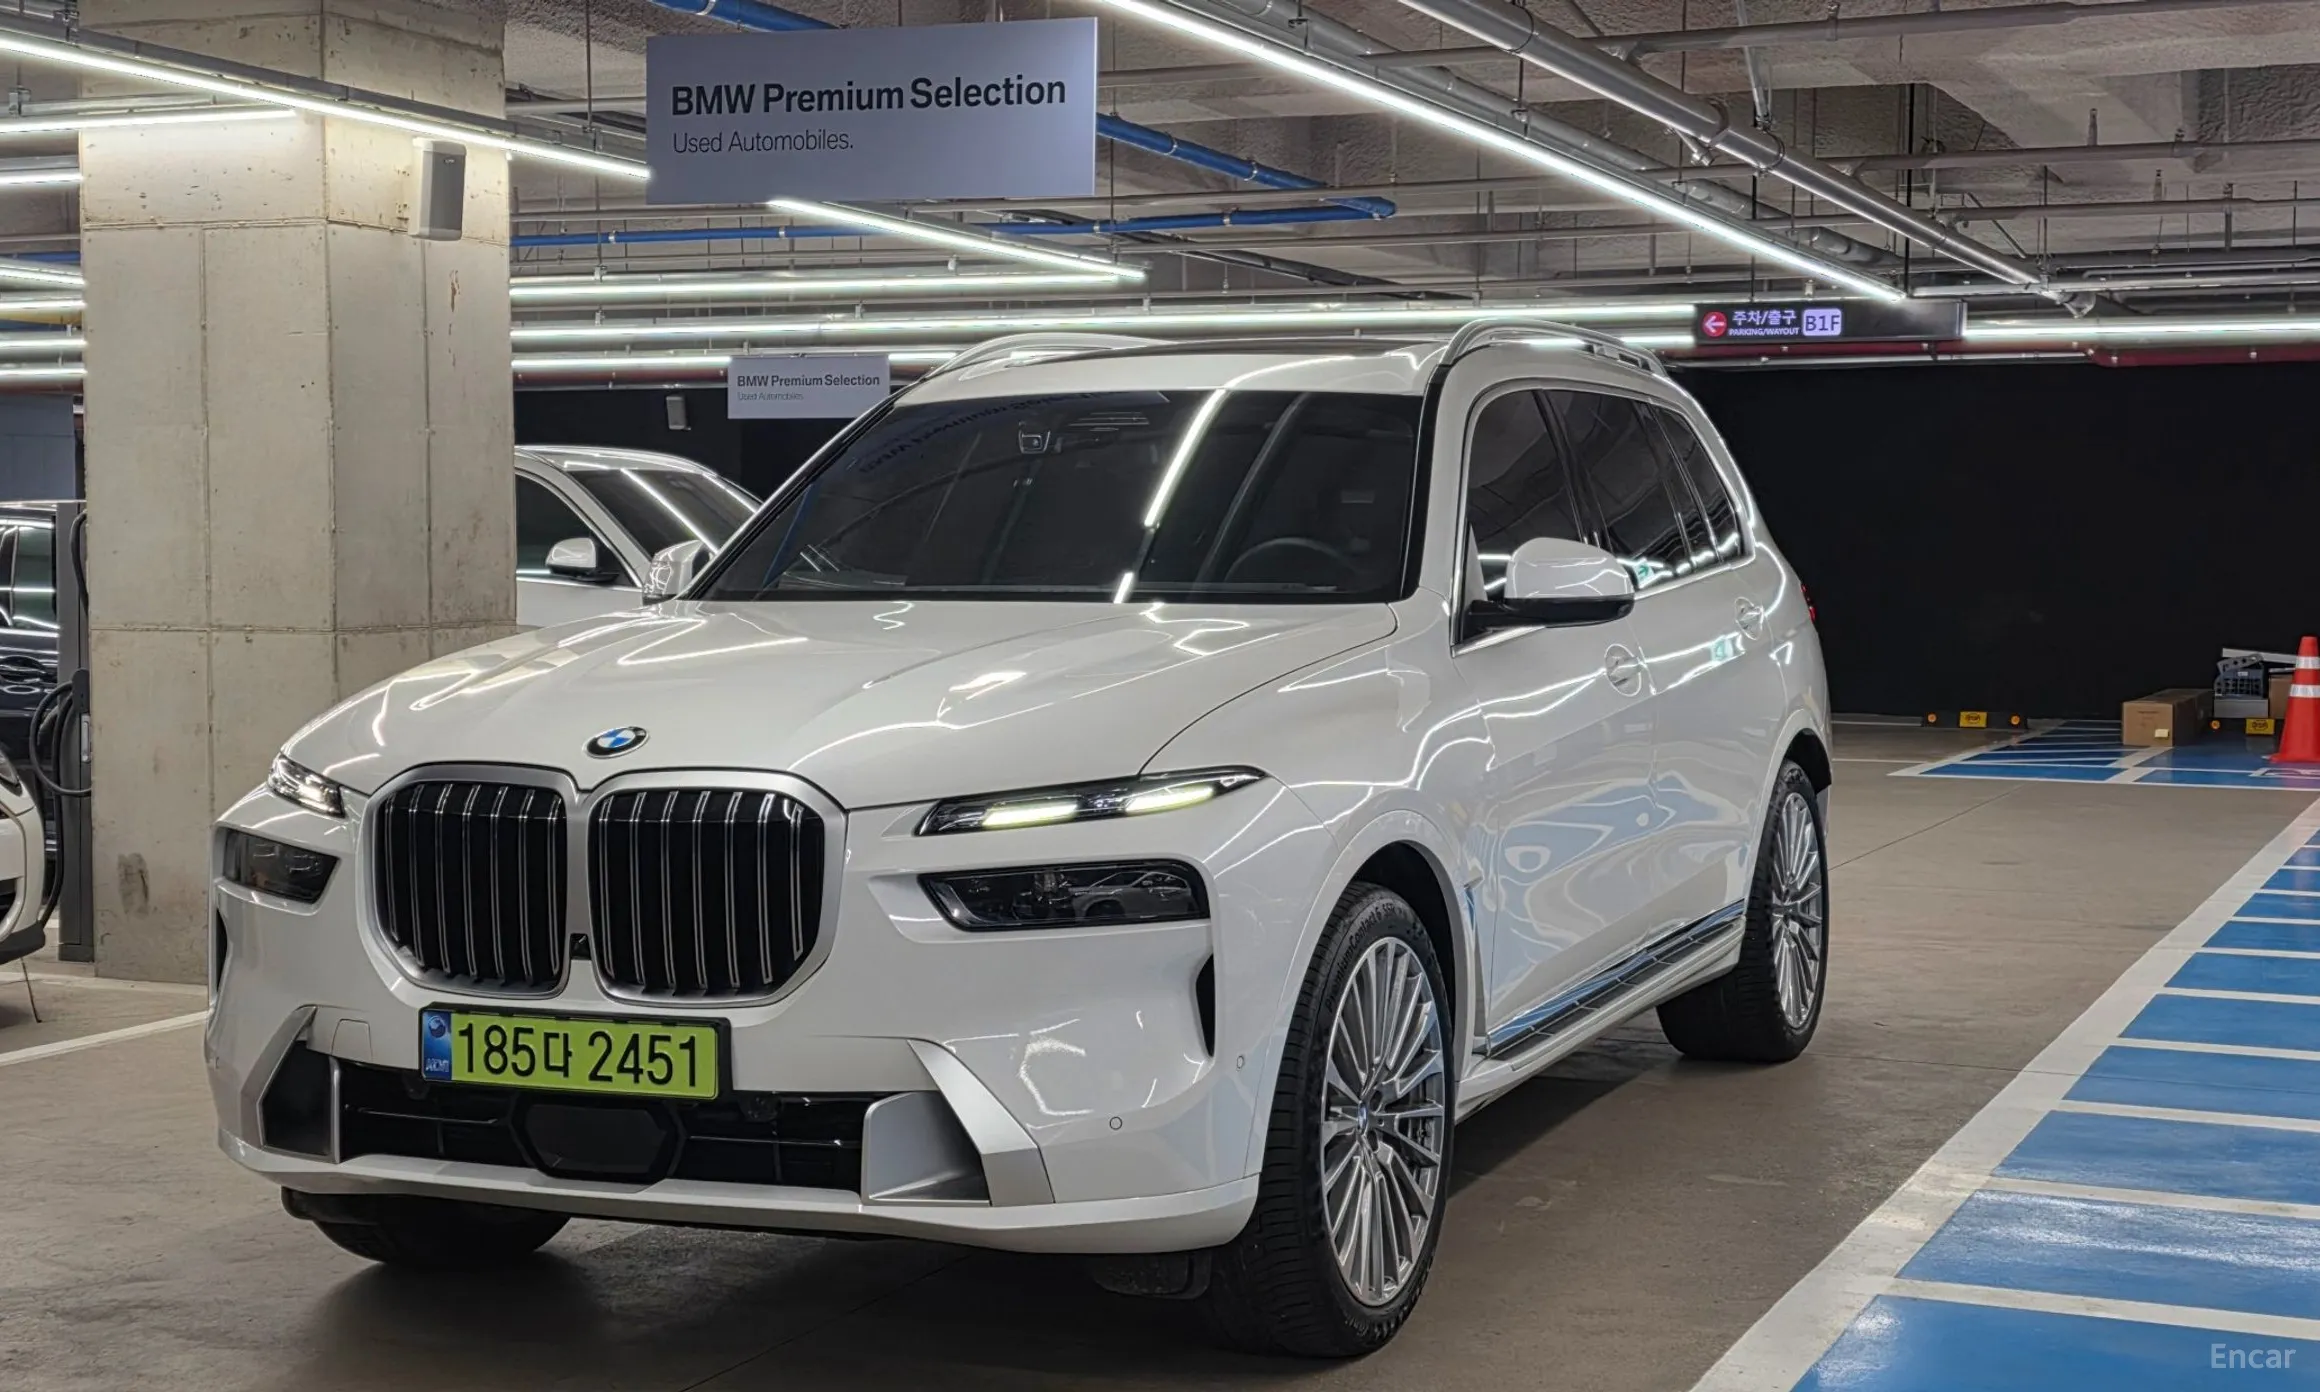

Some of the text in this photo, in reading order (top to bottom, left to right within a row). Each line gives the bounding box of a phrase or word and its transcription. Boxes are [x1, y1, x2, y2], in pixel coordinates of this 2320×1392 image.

[671, 74, 1066, 116] BMW Premium Selection
[673, 129, 854, 154] Used Automobiles.
[1732, 309, 1797, 326] 주차/출구
[1805, 315, 1840, 332] B1F
[737, 374, 880, 387] BMW Premium Selection
[458, 1022, 697, 1087] 185다 2451
